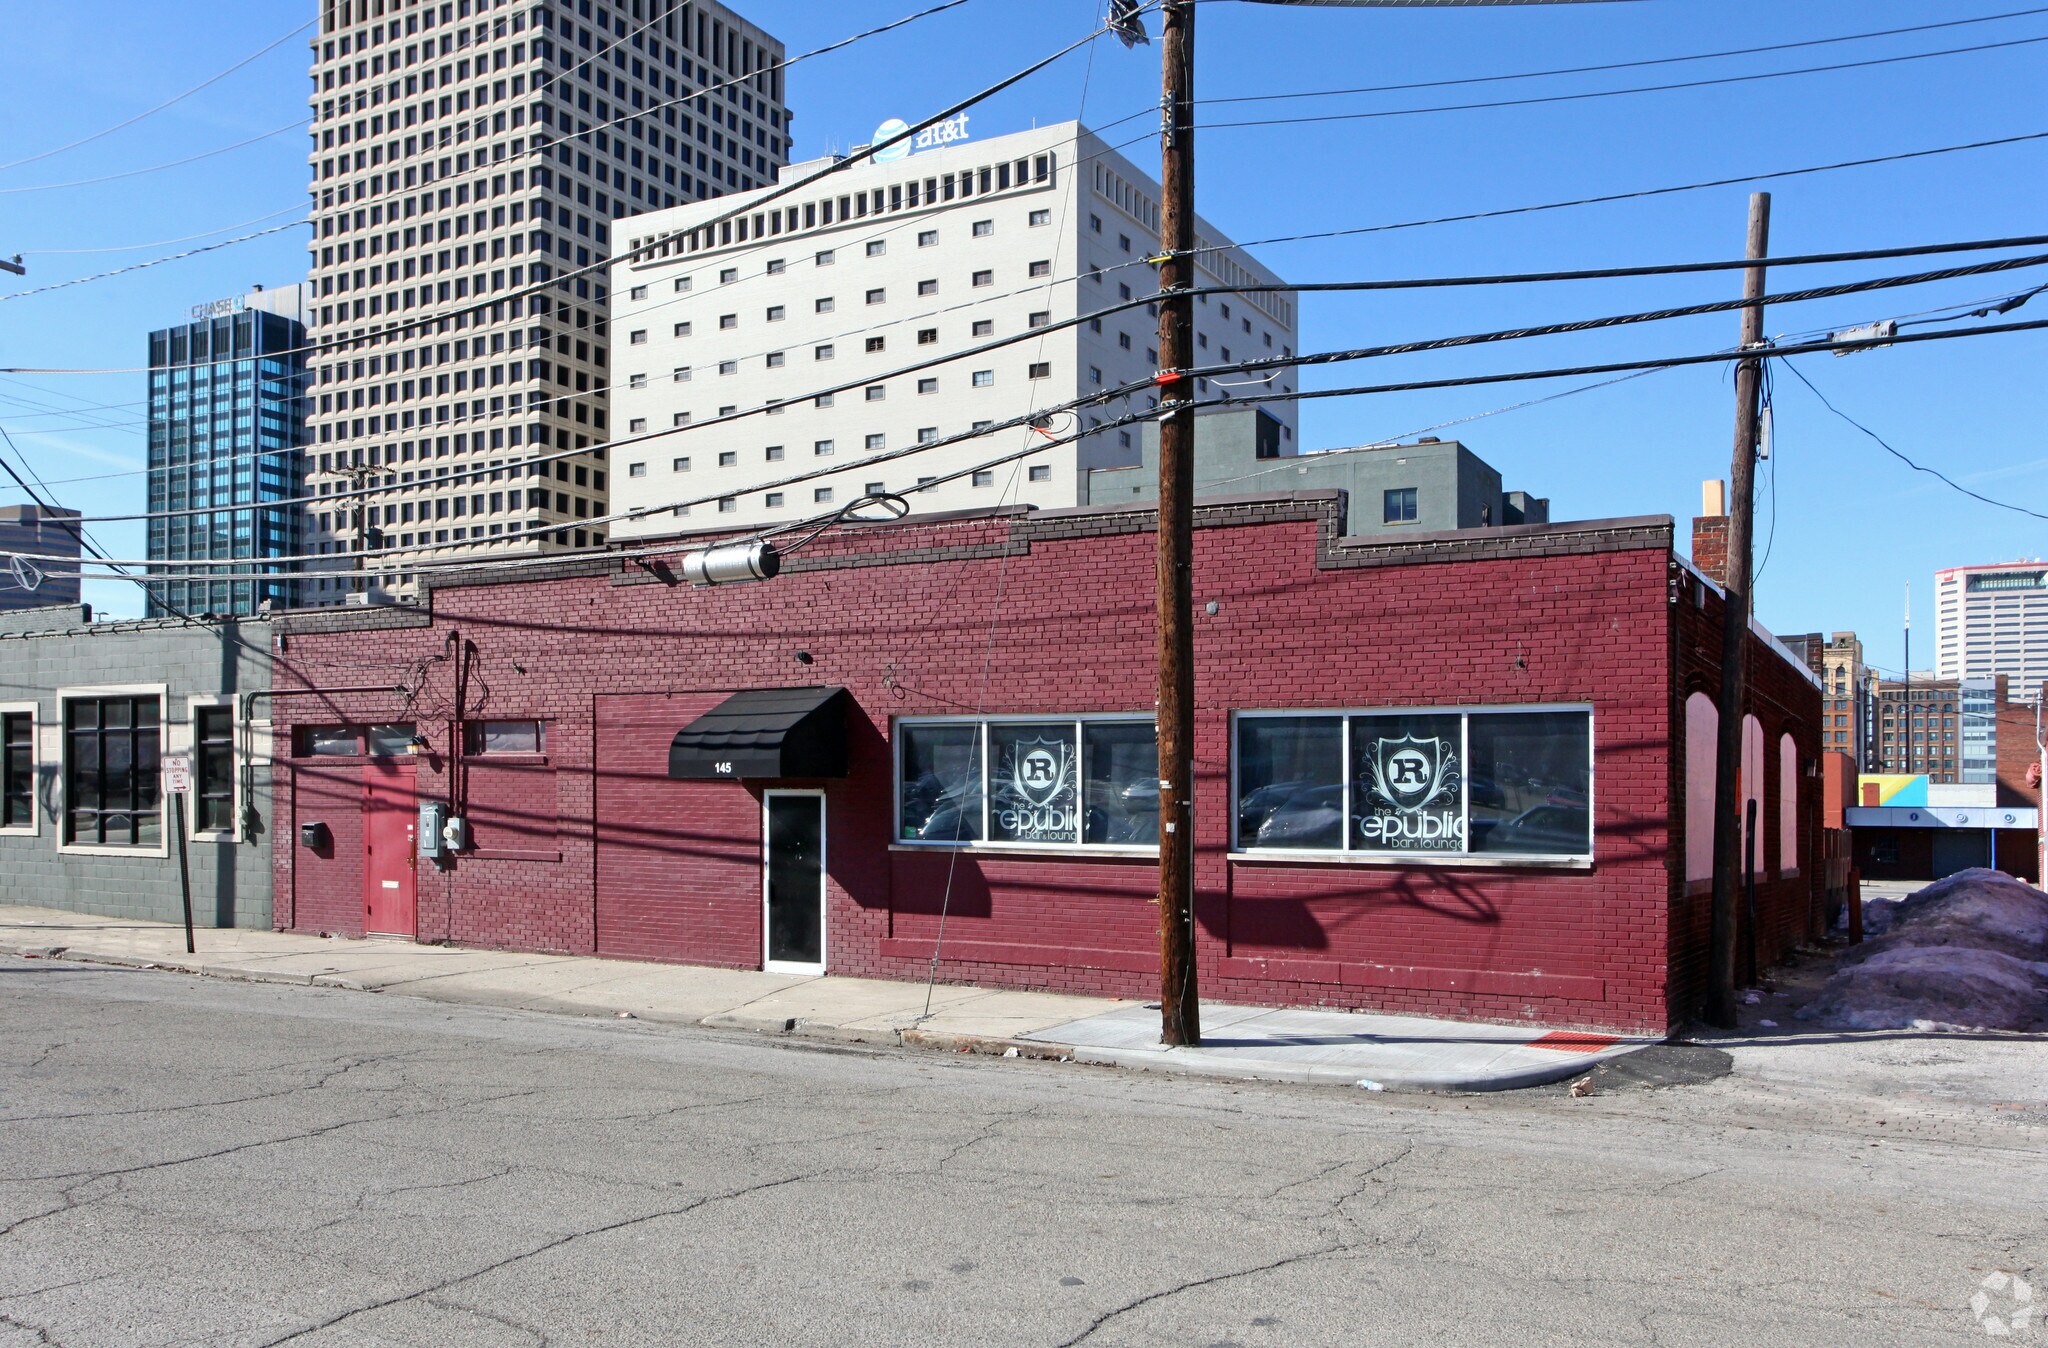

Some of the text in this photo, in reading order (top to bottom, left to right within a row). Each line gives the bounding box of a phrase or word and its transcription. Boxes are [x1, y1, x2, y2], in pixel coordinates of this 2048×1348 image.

[916, 112, 969, 148] at&t
[191, 298, 232, 318] CHASE
[714, 762, 732, 773] 145
[1027, 758, 1054, 781] R
[1392, 758, 1428, 784] R
[1012, 802, 1025, 810] the
[1374, 807, 1392, 816] the
[1025, 829, 1042, 840] bar
[1047, 830, 1077, 843] loung
[1391, 837, 1414, 848] bar
